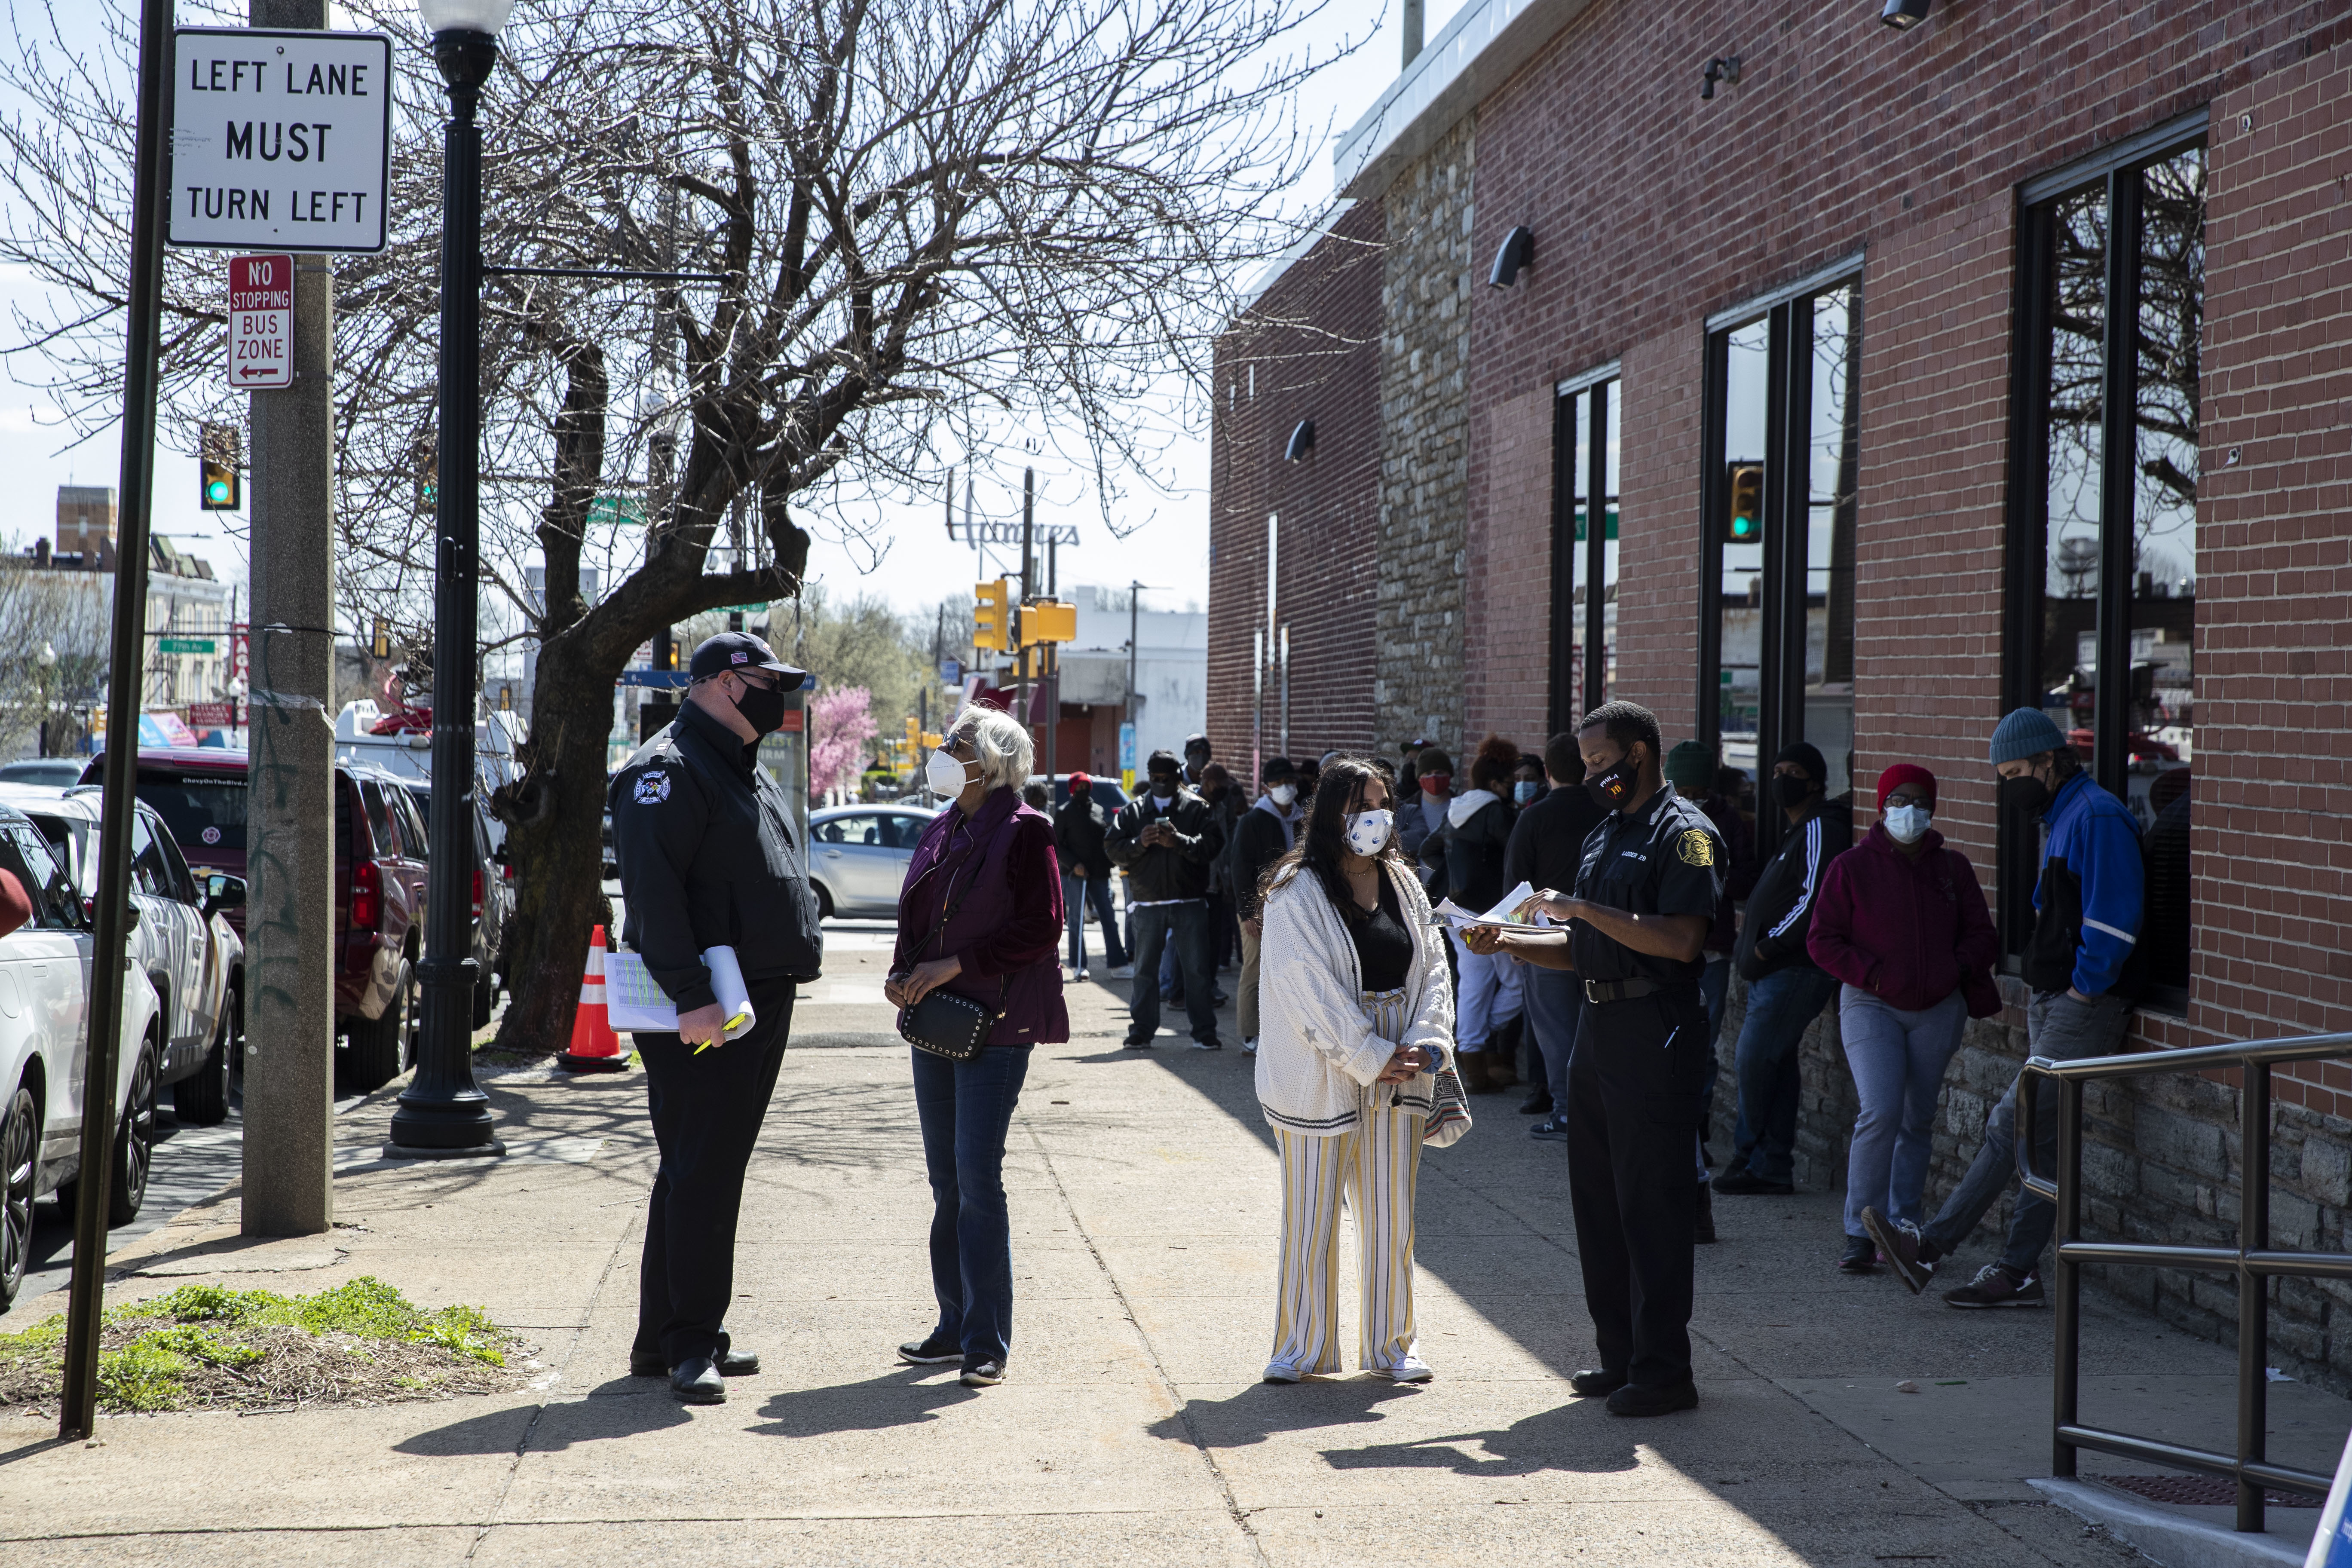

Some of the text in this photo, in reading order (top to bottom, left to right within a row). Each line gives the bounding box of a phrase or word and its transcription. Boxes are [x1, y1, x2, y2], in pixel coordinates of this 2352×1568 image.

[191, 59, 368, 96] LEFT LANE
[226, 121, 332, 162] MUST
[187, 187, 367, 223] TURN LEFT
[248, 261, 272, 286] NO
[233, 288, 289, 310] STOPPING
[243, 315, 278, 335] BUS
[237, 338, 284, 359] ZONE
[1600, 774, 1619, 787] PHILA
[1611, 785, 1621, 795] FD
